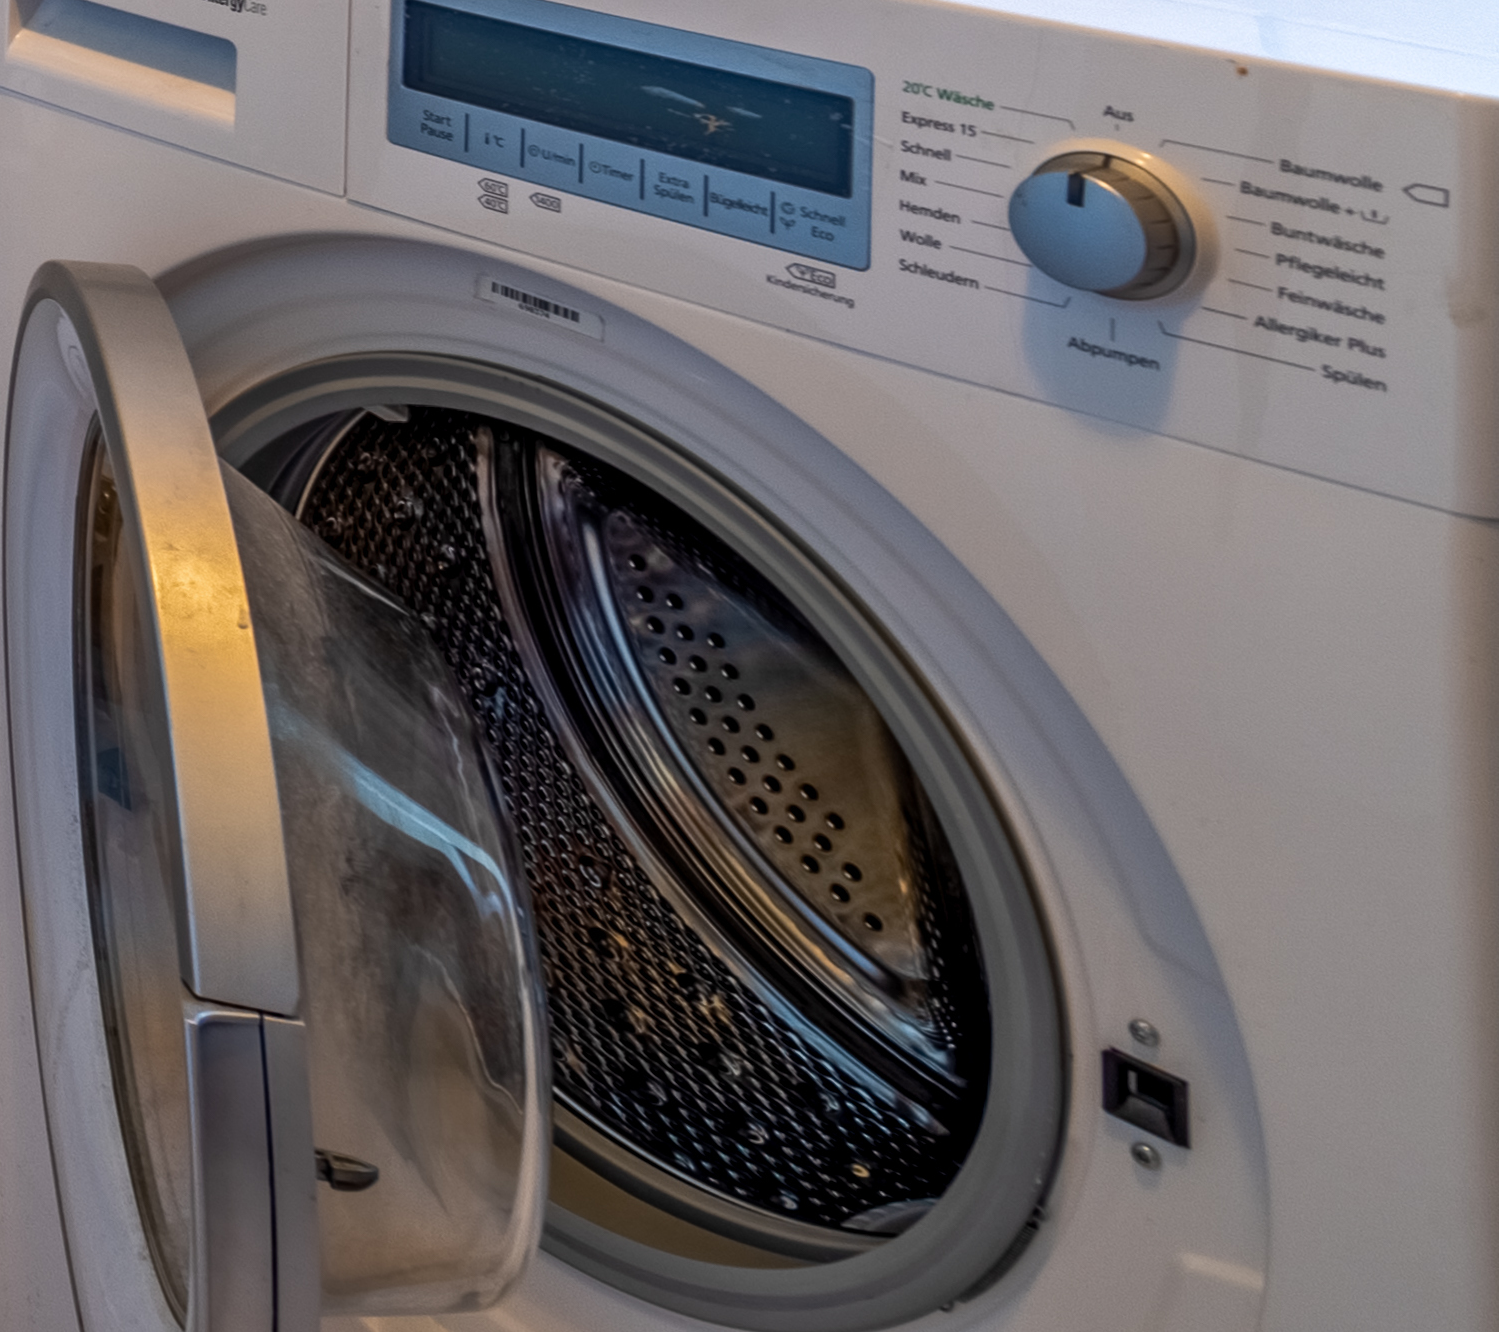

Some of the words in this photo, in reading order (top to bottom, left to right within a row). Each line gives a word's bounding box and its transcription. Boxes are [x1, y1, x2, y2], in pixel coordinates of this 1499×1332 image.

[936, 87, 995, 111] Wäsche
[423, 109, 452, 127] Start
[901, 111, 955, 134] Express
[960, 123, 978, 137] 15
[1103, 105, 1135, 123] Aus
[420, 122, 454, 142] Pause
[900, 139, 952, 162] Schnell
[602, 163, 635, 182] Timer
[658, 172, 691, 189] Extra
[900, 169, 928, 187] Mix
[1278, 158, 1384, 193] Baumwolle
[654, 184, 695, 204] Spülen
[1240, 180, 1341, 215] Baumwolle
[800, 206, 847, 227] Schnell
[899, 198, 961, 225] Hemden
[810, 226, 835, 242] Eco
[899, 229, 943, 250] Wolle
[1270, 220, 1386, 260] Buntwäsche
[898, 258, 981, 290] Schleudern
[1274, 253, 1386, 292] Pflegeleicht
[766, 273, 855, 309] Kindersicherung
[1277, 286, 1386, 326] Feinwäsche
[1254, 314, 1343, 349] Allergiker
[1348, 337, 1387, 360] Plus
[1067, 336, 1161, 372] Abpumpen
[1321, 364, 1388, 393] Spülen
